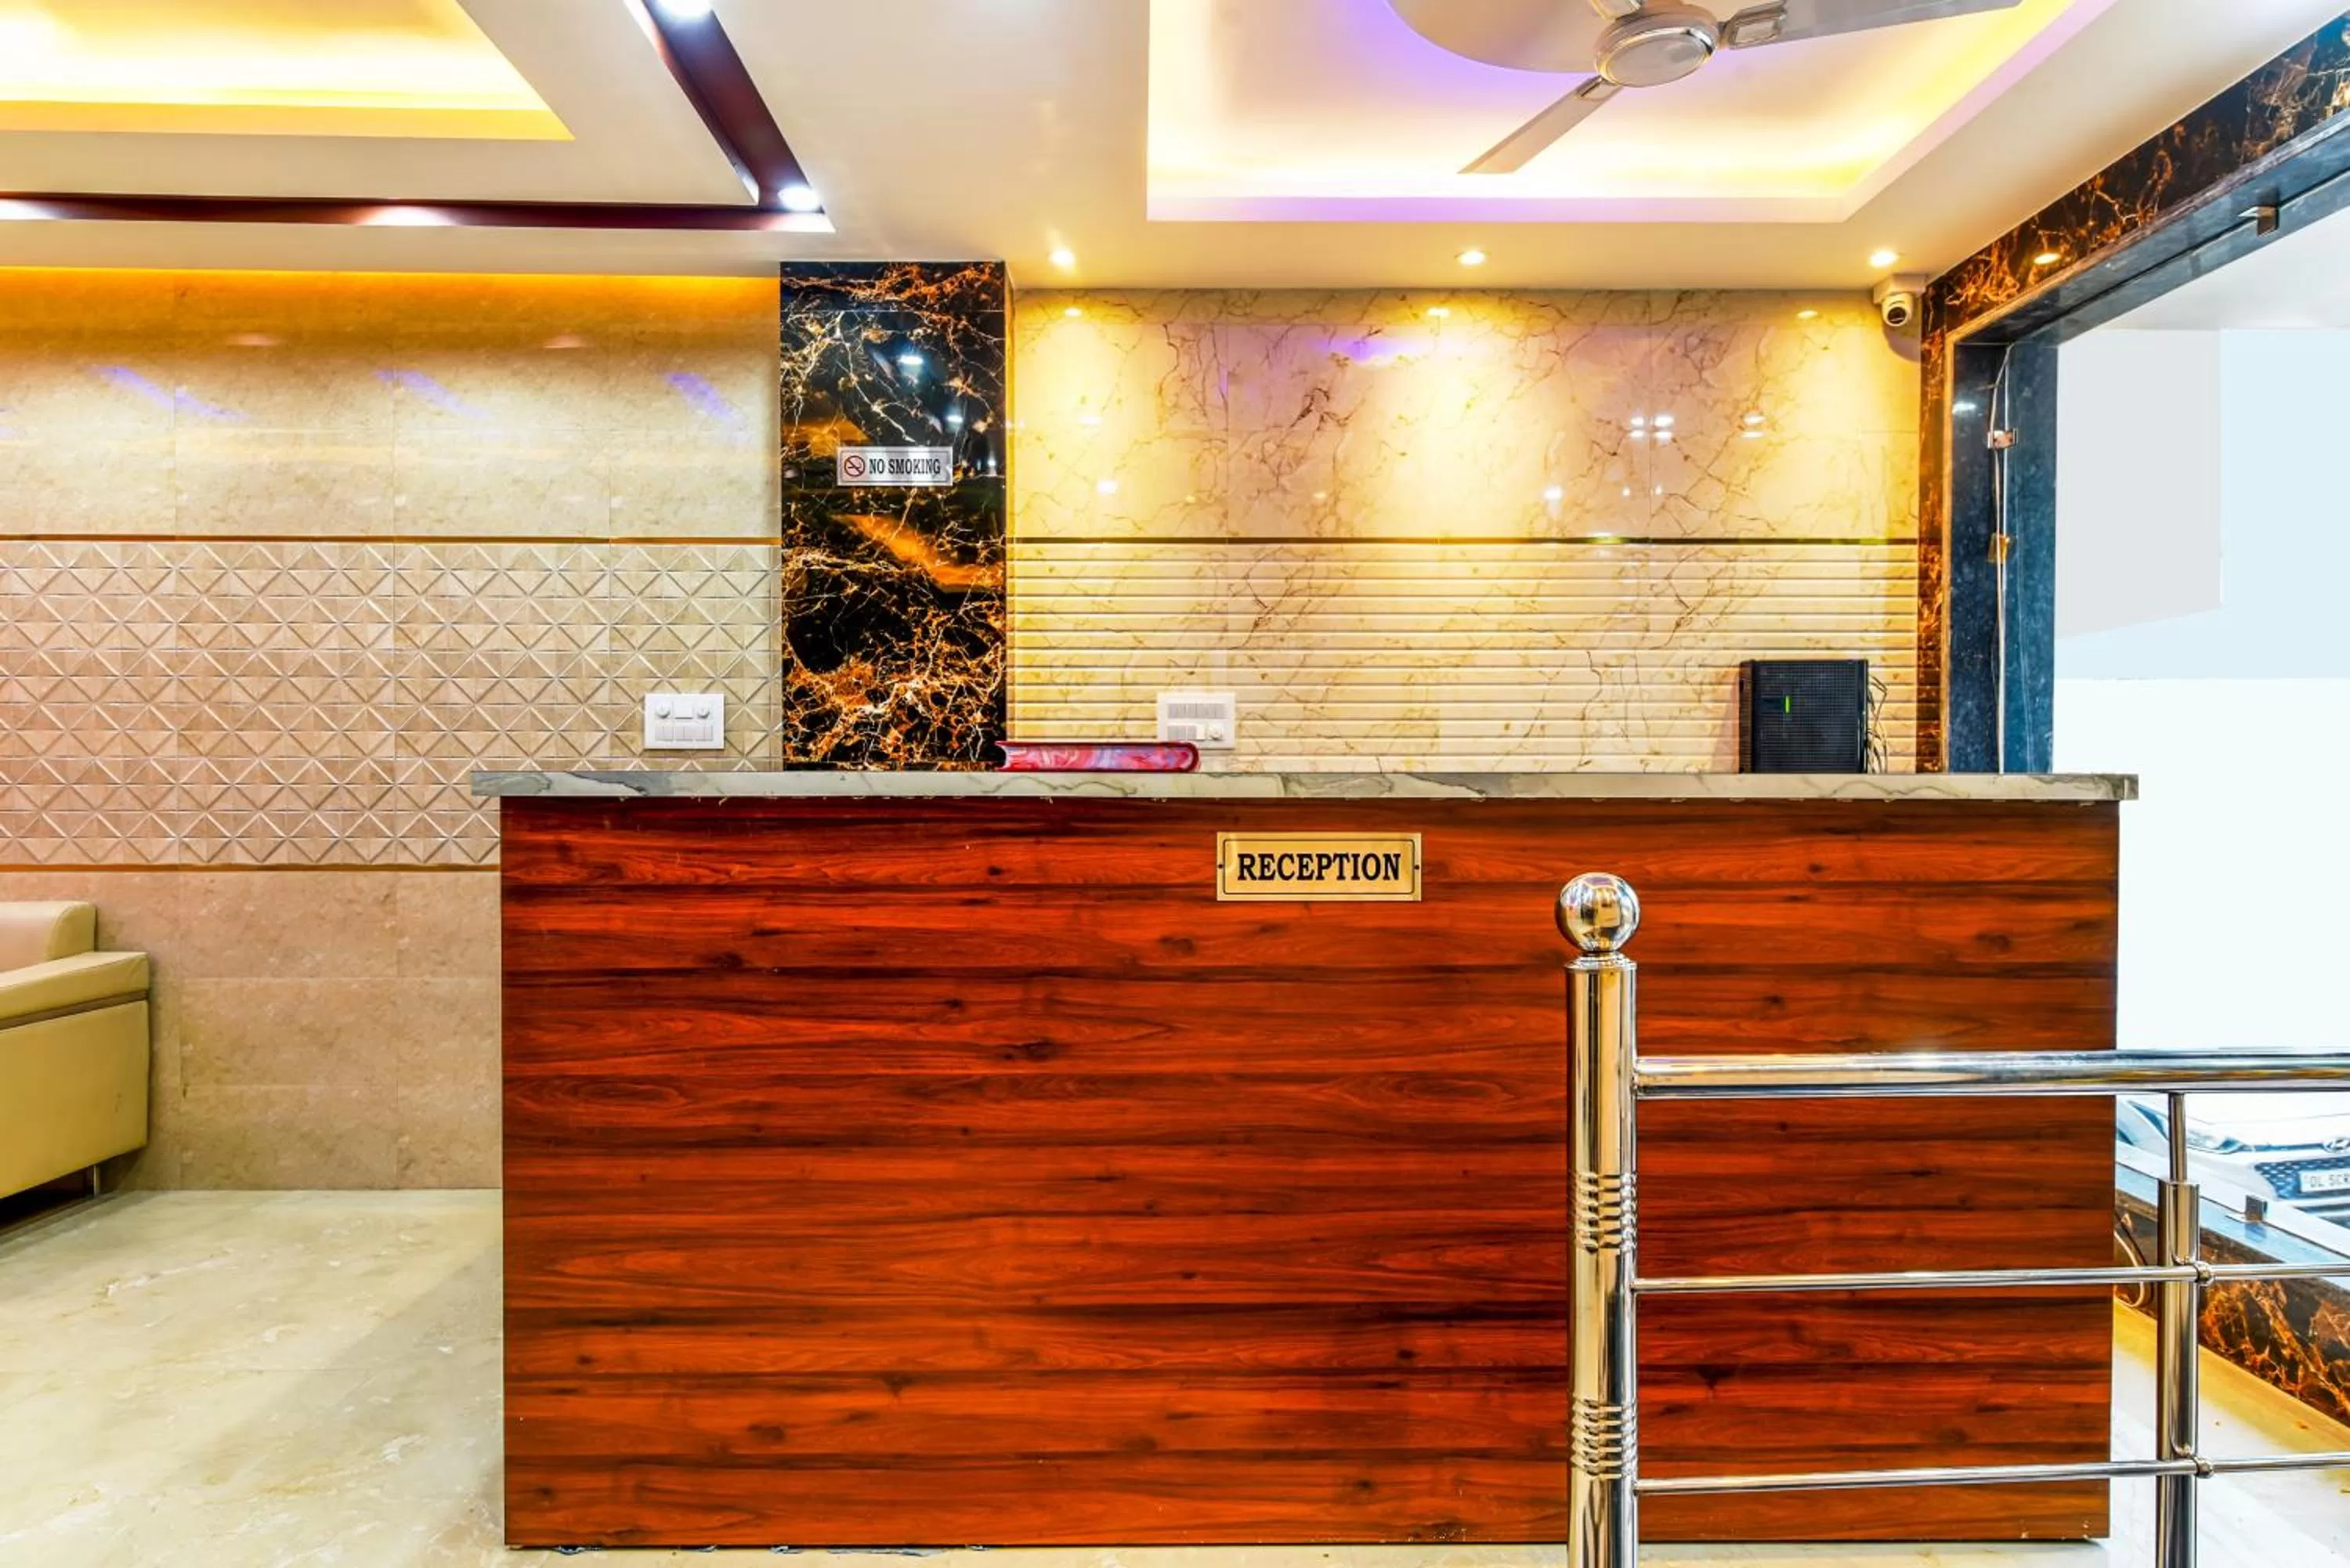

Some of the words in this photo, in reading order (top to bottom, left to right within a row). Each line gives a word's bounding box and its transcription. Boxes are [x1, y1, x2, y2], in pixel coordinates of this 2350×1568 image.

[869, 458, 885, 474] NO
[888, 458, 941, 474] SMOKING
[1237, 853, 1401, 880] RECEPTION
